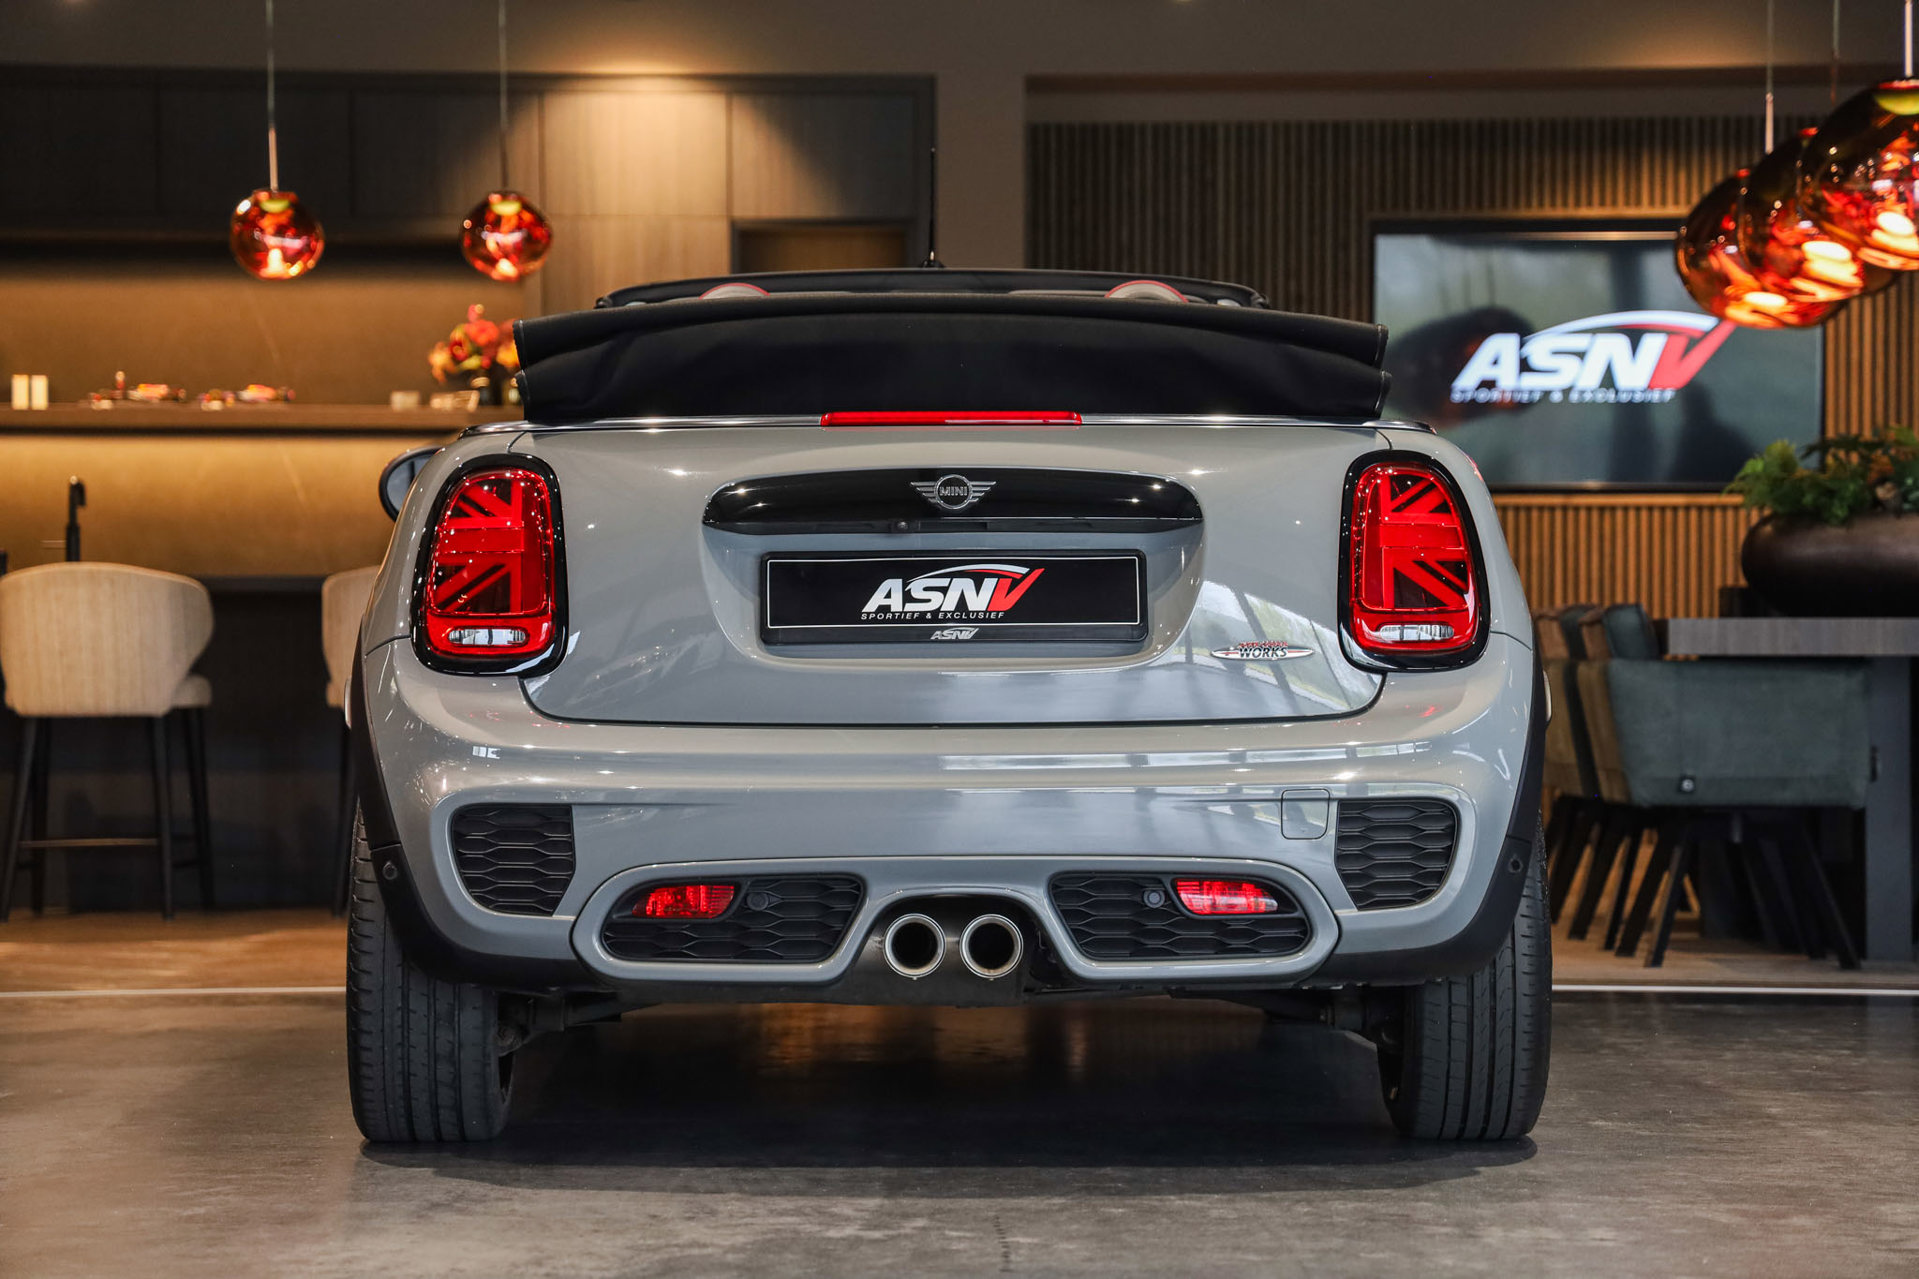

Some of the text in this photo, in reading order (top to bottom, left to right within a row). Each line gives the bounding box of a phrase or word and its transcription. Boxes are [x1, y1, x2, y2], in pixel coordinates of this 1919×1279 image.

[1451, 312, 1738, 389] ASNV
[940, 486, 968, 496] MINI
[861, 564, 1045, 612] ASNV
[861, 612, 920, 620] SPORTIEF
[930, 627, 979, 640] ASNV
[1240, 647, 1287, 658] WORKS
